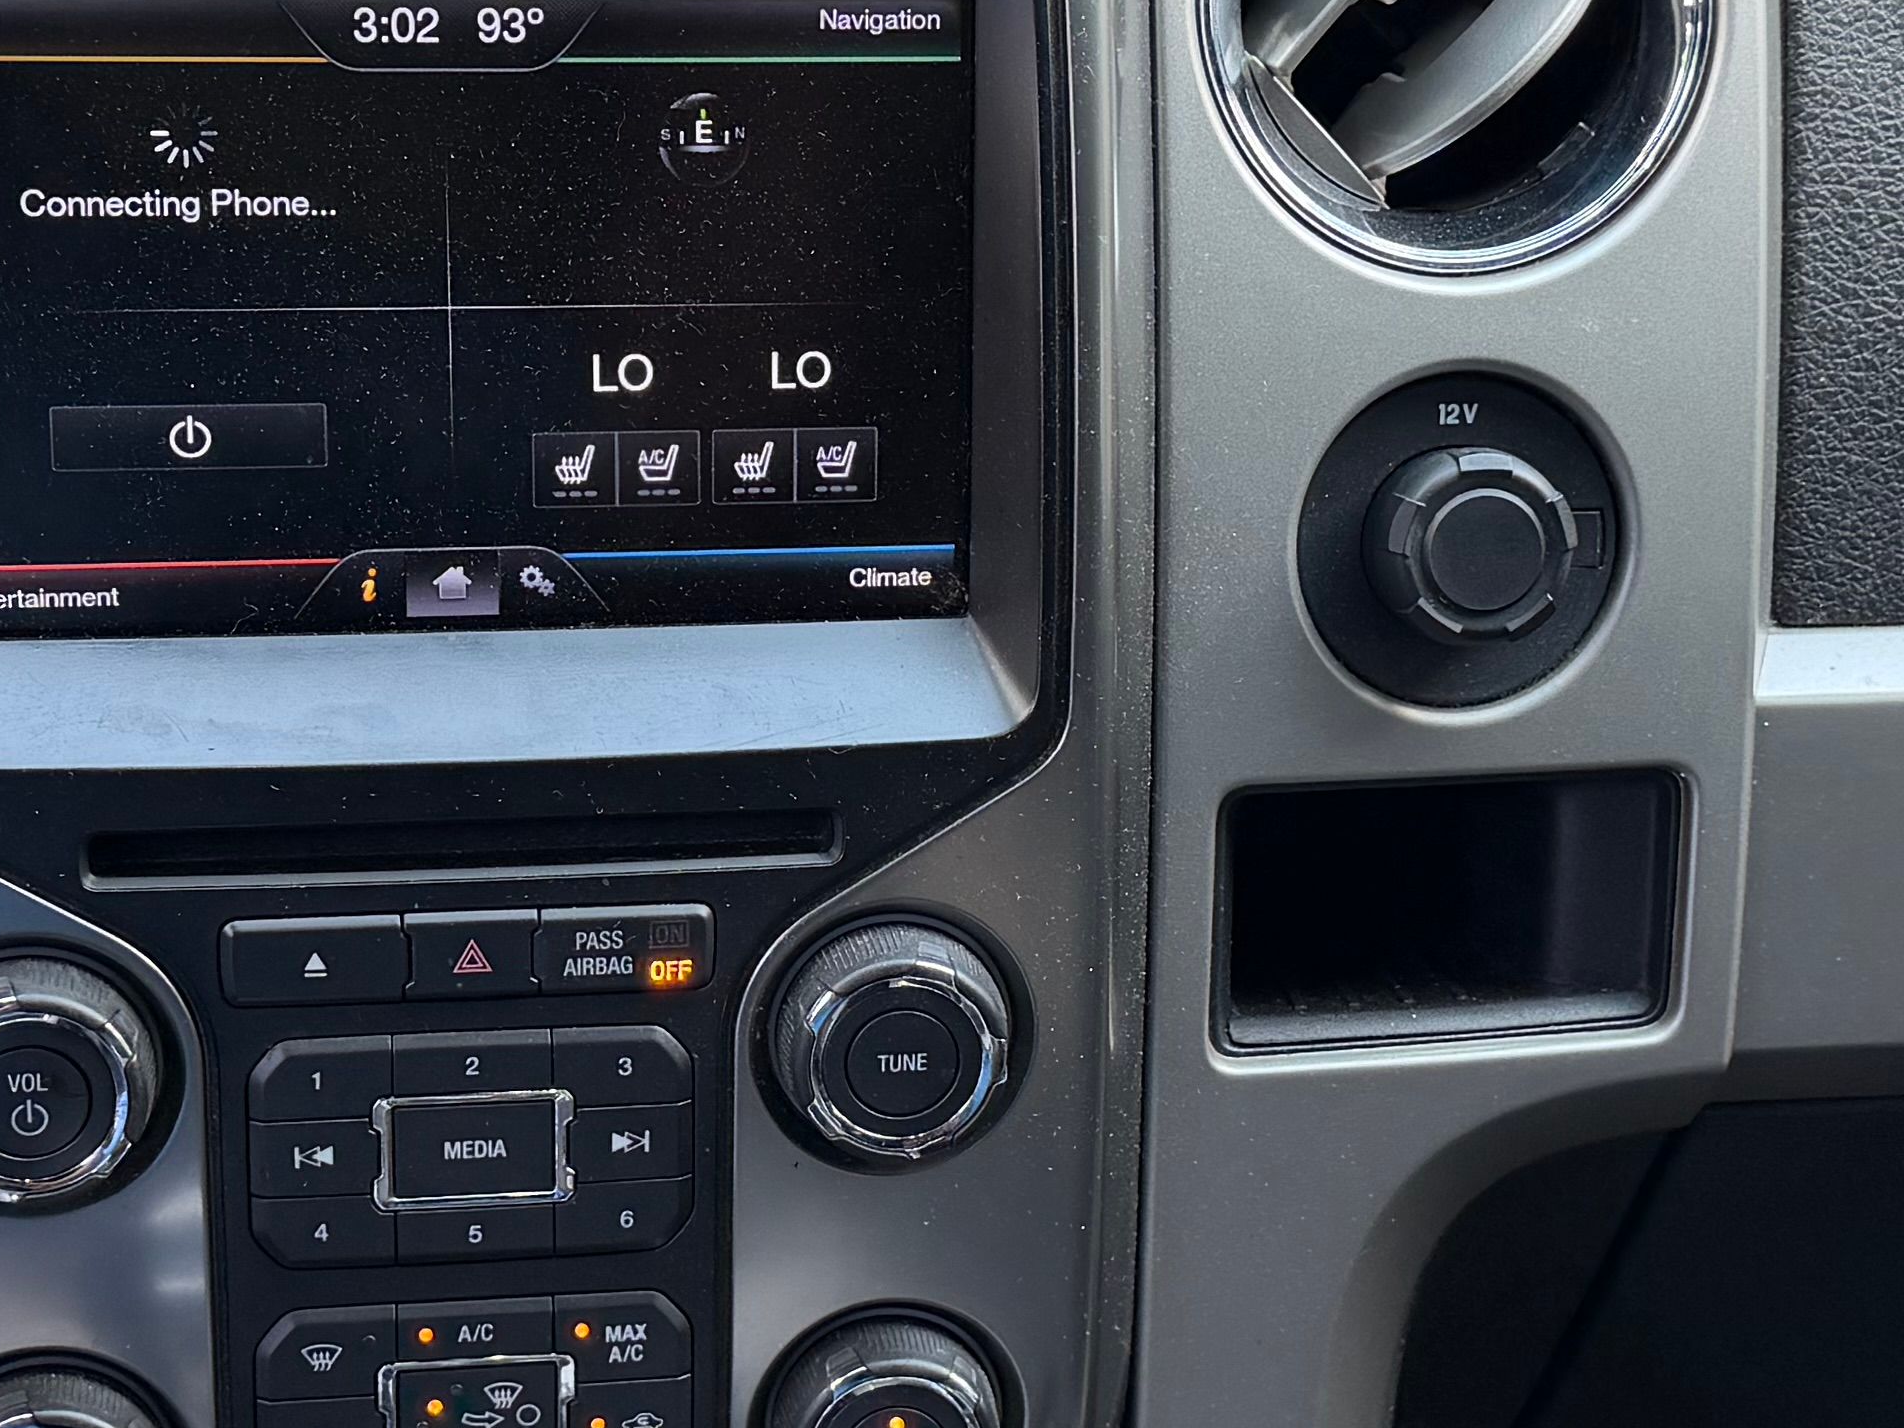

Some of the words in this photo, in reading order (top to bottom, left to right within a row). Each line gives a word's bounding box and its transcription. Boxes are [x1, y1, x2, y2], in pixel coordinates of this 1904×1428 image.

[351, 6, 440, 43] 3:02
[818, 9, 941, 33] Navigation
[694, 121, 713, 144] E
[19, 189, 200, 223] Connecting
[210, 189, 338, 218] Phone...
[592, 353, 655, 393] LO
[769, 350, 832, 390] LO
[637, 448, 664, 465] A/C
[815, 446, 842, 462] A/C
[848, 567, 933, 588] Climate
[575, 930, 625, 952] PASS
[562, 955, 635, 978] AIRBAG
[649, 959, 693, 983] OFF
[464, 1056, 481, 1076] 2
[618, 1056, 633, 1077] 3
[876, 1053, 928, 1074] TUNE
[7, 1073, 49, 1093] VOL
[311, 1071, 323, 1090] 1
[443, 1139, 508, 1161] MEDIA
[619, 1209, 635, 1230] 6
[313, 1224, 329, 1242] 4
[467, 1224, 484, 1245] 5
[457, 1323, 495, 1345] A/C
[604, 1323, 648, 1344] MAX
[608, 1341, 645, 1363] A/C
